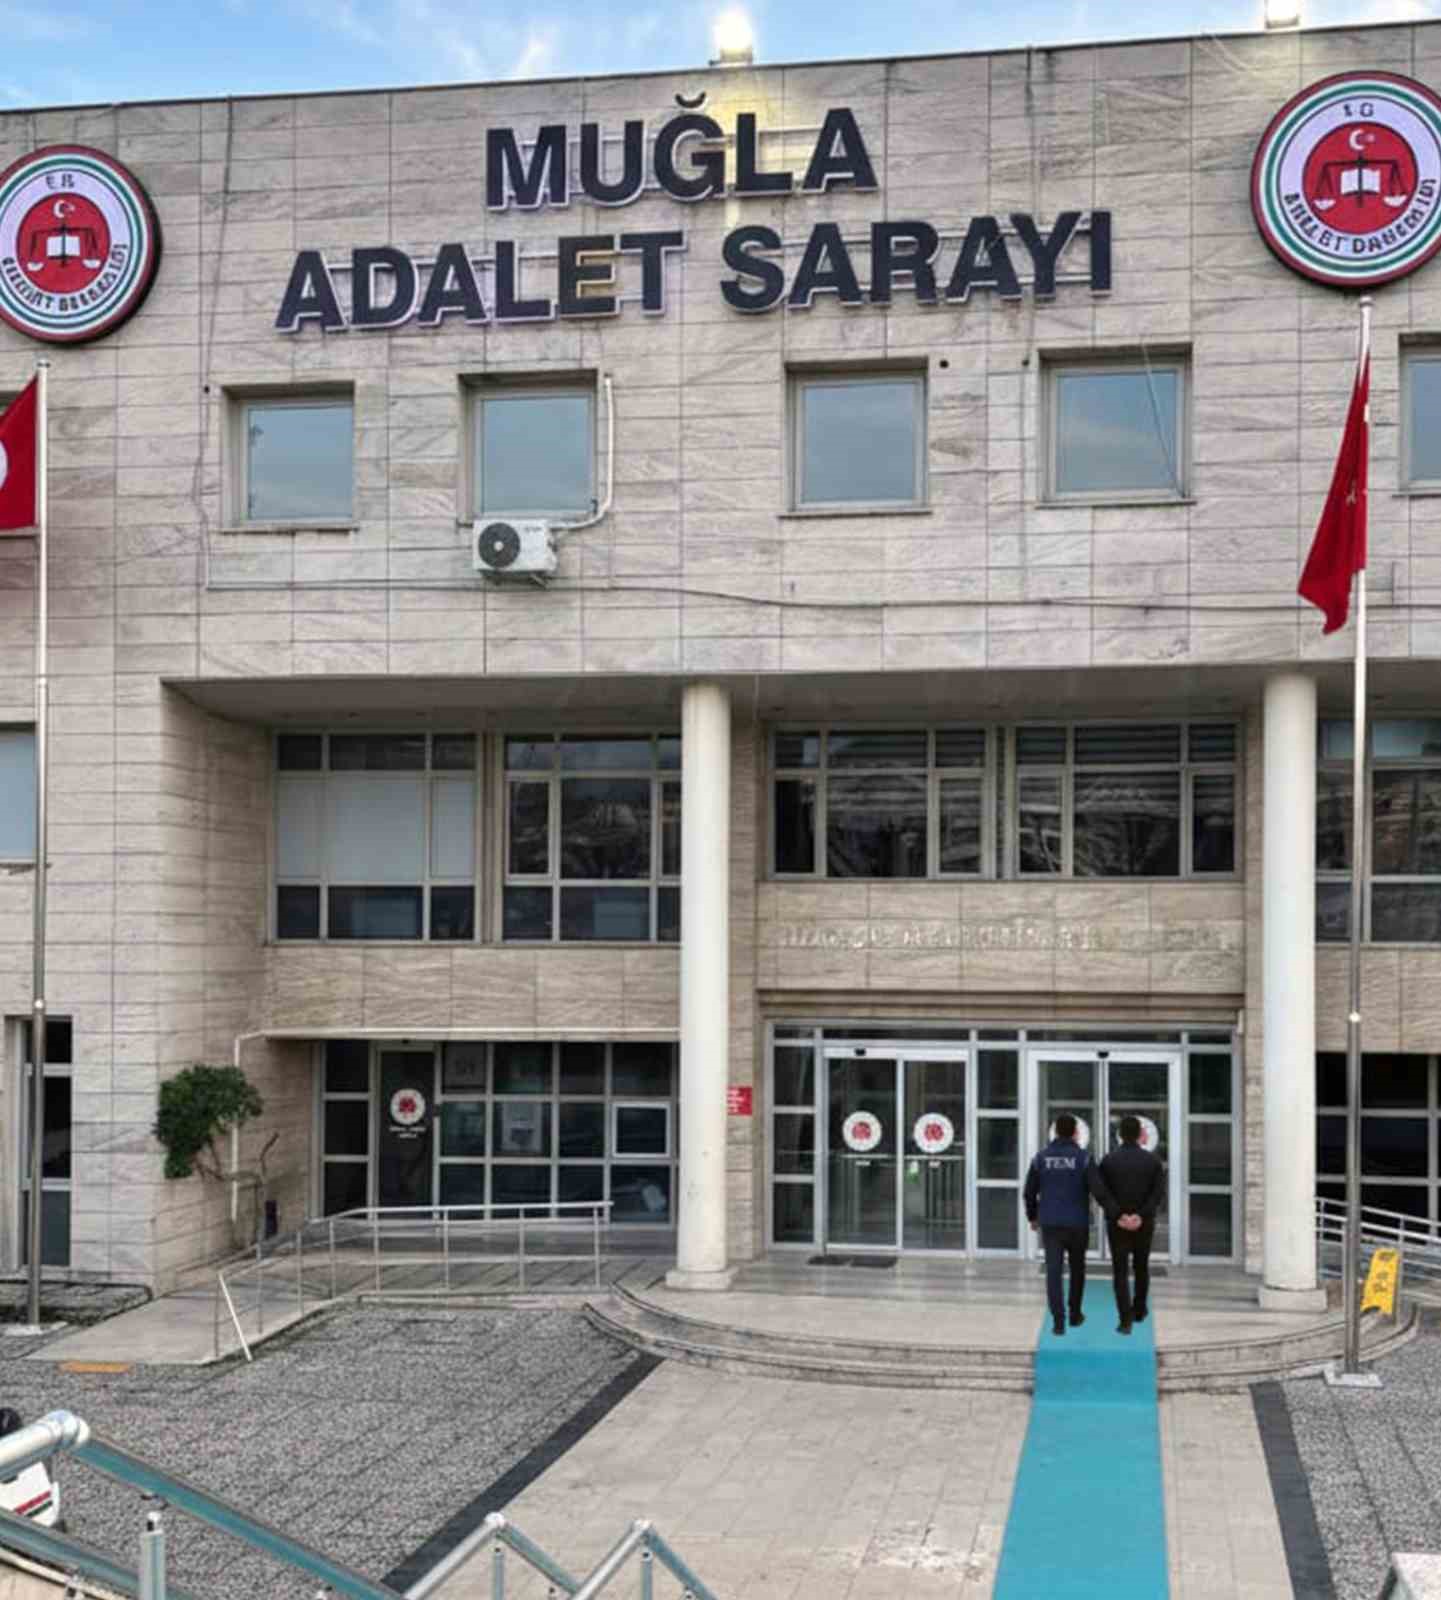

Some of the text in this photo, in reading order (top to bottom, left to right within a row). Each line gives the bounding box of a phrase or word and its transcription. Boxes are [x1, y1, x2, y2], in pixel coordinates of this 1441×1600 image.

[485, 91, 879, 212] MUĞLA
[274, 209, 1113, 335] ADALET SARAYI
[1044, 1156, 1076, 1169] TEM
